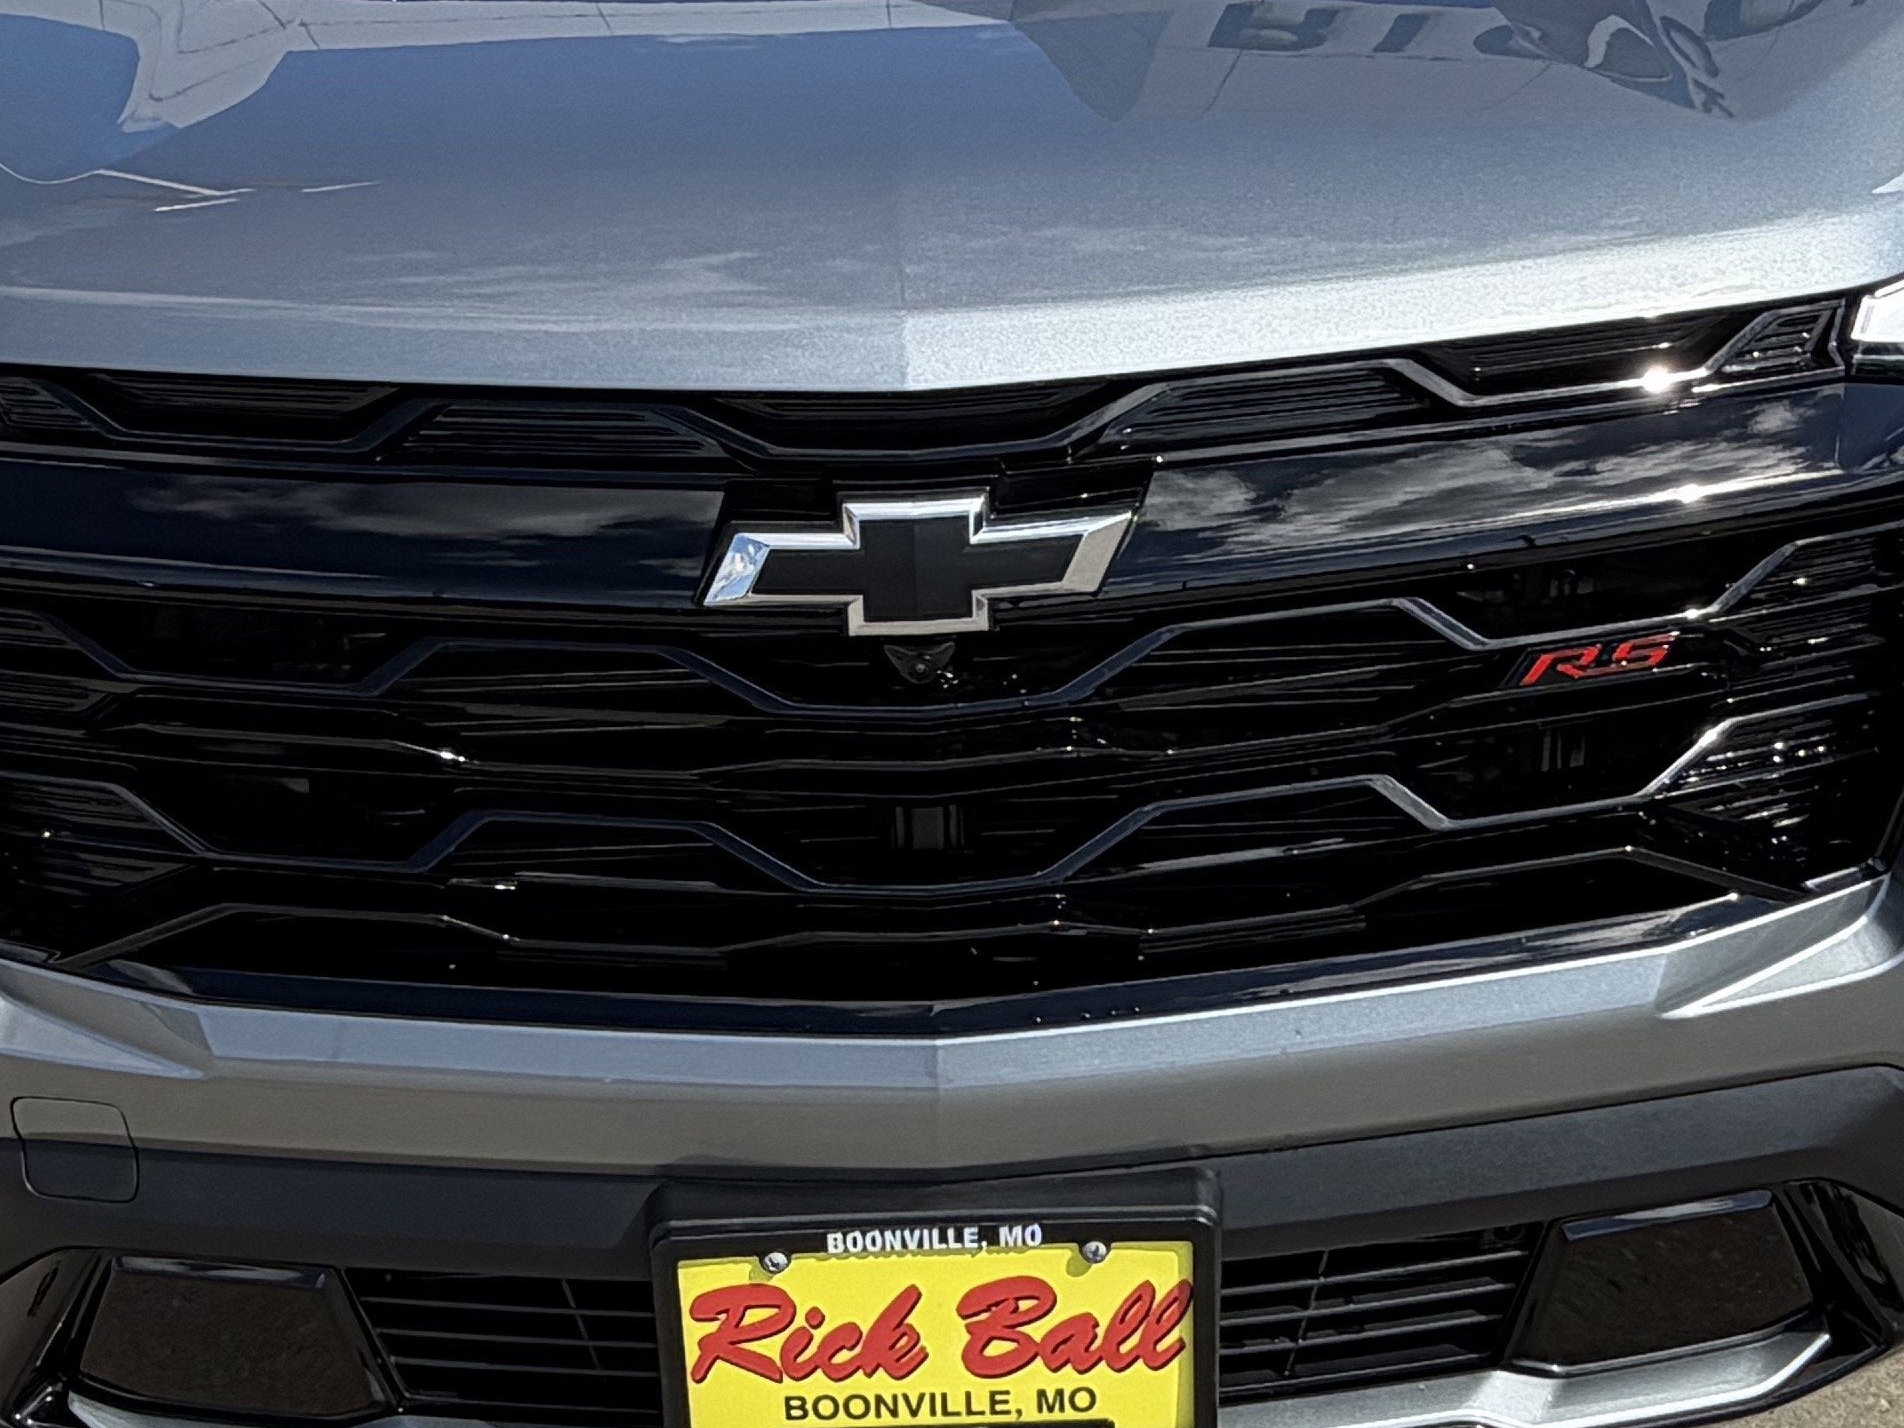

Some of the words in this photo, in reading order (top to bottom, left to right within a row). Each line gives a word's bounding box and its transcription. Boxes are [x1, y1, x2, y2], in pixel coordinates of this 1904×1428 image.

[1519, 630, 1680, 686] RS
[827, 1226, 989, 1254] BOONVILLE,
[999, 1223, 1043, 1249] MO
[690, 1282, 929, 1385] Rick
[956, 1274, 1193, 1380] Ball
[783, 1389, 1023, 1422] BOONVILLE,
[1036, 1386, 1097, 1415] MO
